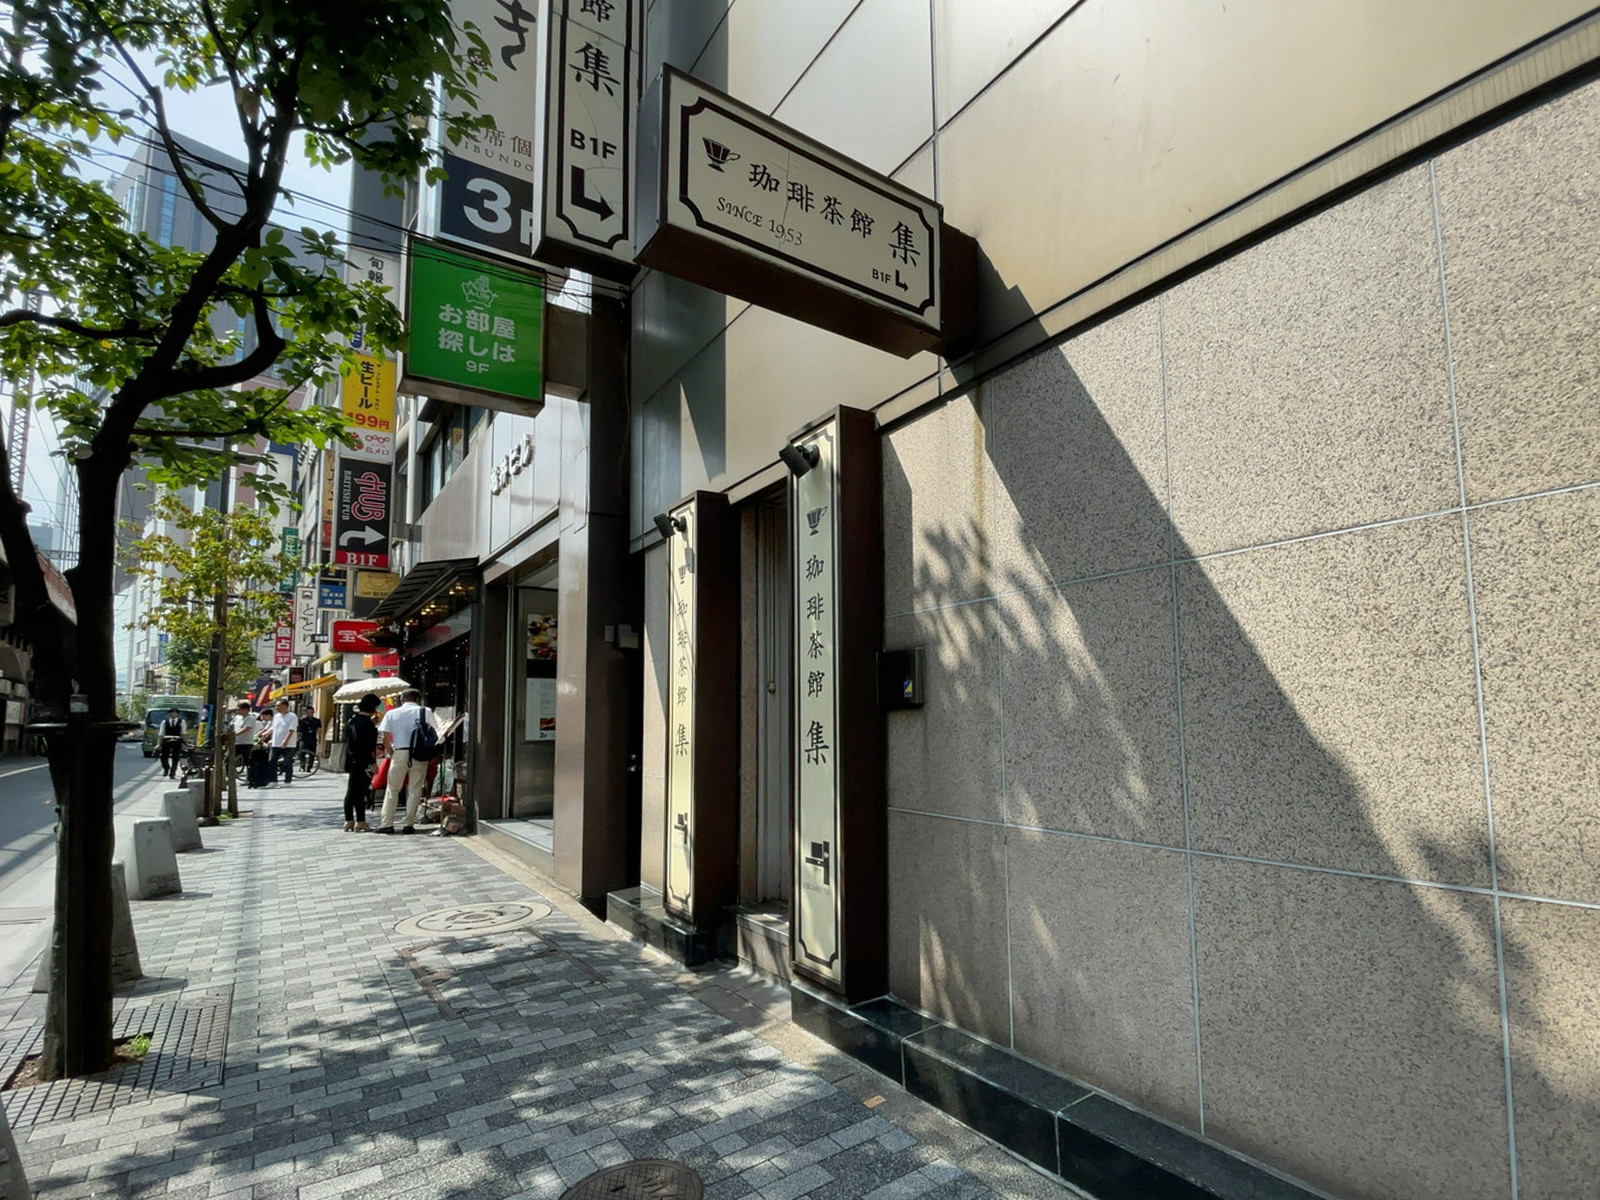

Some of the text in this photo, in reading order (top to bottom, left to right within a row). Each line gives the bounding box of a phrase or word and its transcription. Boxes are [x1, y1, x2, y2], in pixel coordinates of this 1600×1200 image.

[570, 128, 617, 160] B1F
[716, 197, 803, 247] SINCE 1953
[872, 268, 892, 284] B1F
[438, 303, 516, 340] お部屋
[438, 328, 516, 363] 探しは
[466, 360, 490, 374] 9F
[358, 360, 374, 409] 生ビール
[342, 470, 352, 504] BRITISH
[351, 471, 386, 521] HUB
[346, 552, 378, 567] B1F
